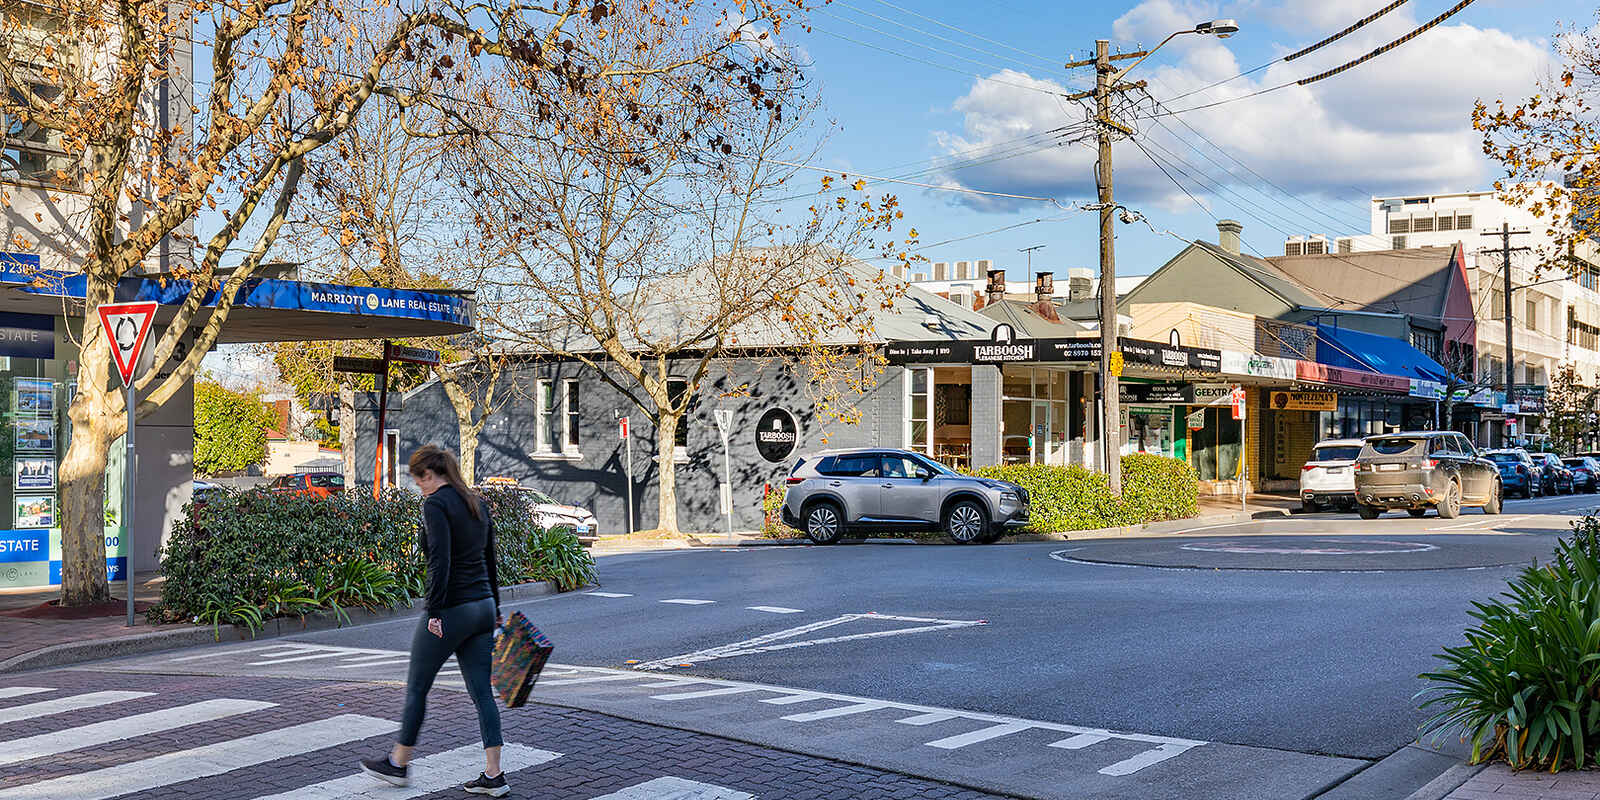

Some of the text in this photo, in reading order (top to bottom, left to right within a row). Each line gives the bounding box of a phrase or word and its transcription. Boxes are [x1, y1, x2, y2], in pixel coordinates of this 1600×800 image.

[311, 292, 365, 306] MARRIOTT
[381, 299, 406, 309] LANE
[408, 300, 427, 311] REAL
[428, 302, 450, 314] ESTATE
[0, 331, 39, 342] STATE
[973, 345, 1033, 360] TARBOOSH
[1161, 349, 1188, 366] TARBOOSH
[760, 432, 795, 441] TARBOOSH
[0, 539, 40, 552] STATE
